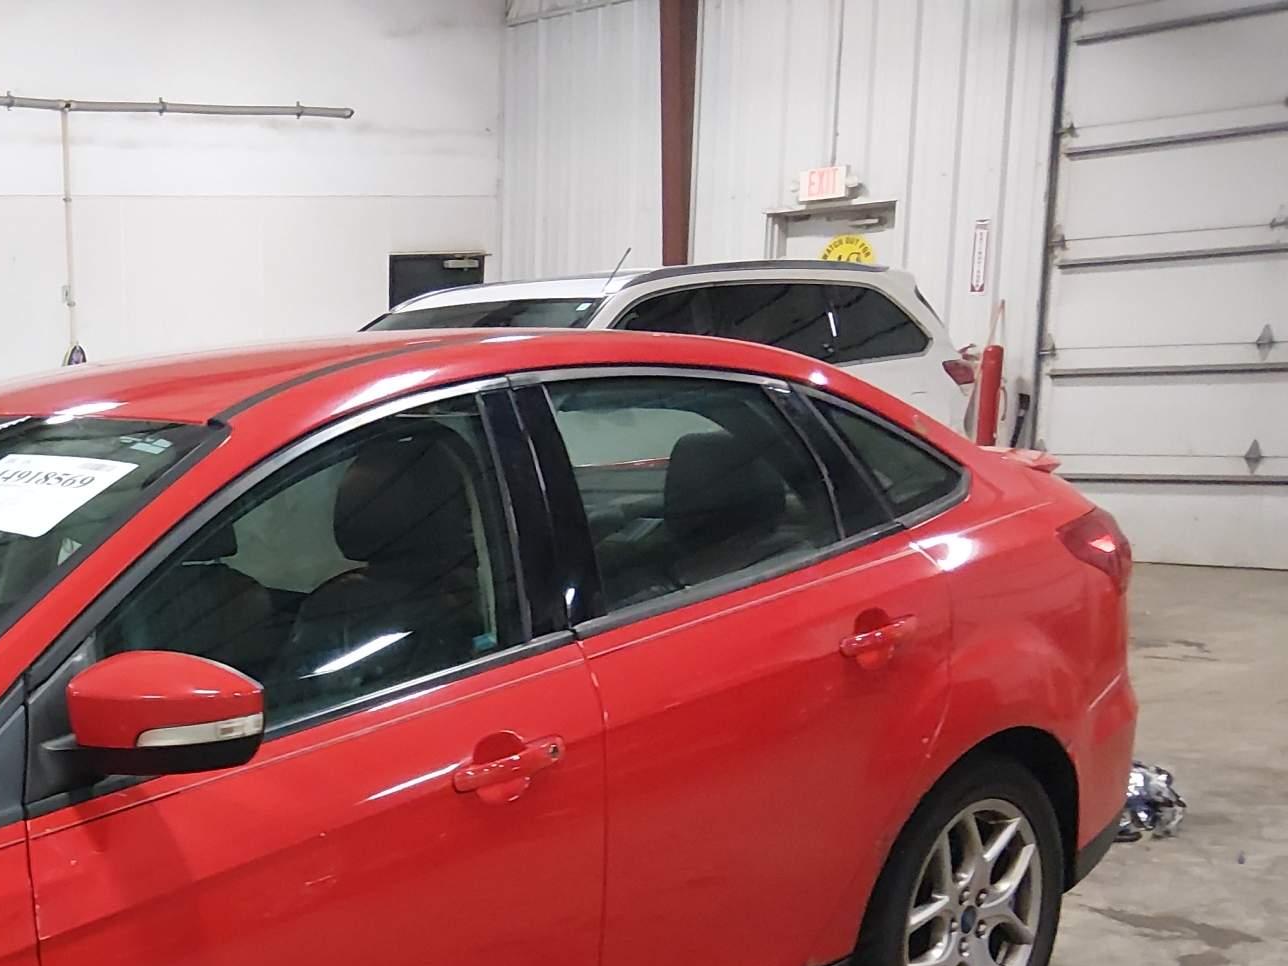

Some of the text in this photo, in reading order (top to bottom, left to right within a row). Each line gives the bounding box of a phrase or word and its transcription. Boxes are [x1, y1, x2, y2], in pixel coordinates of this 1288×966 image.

[808, 167, 839, 196] EXIT
[845, 236, 860, 246] OUT
[859, 242, 872, 258] FOR
